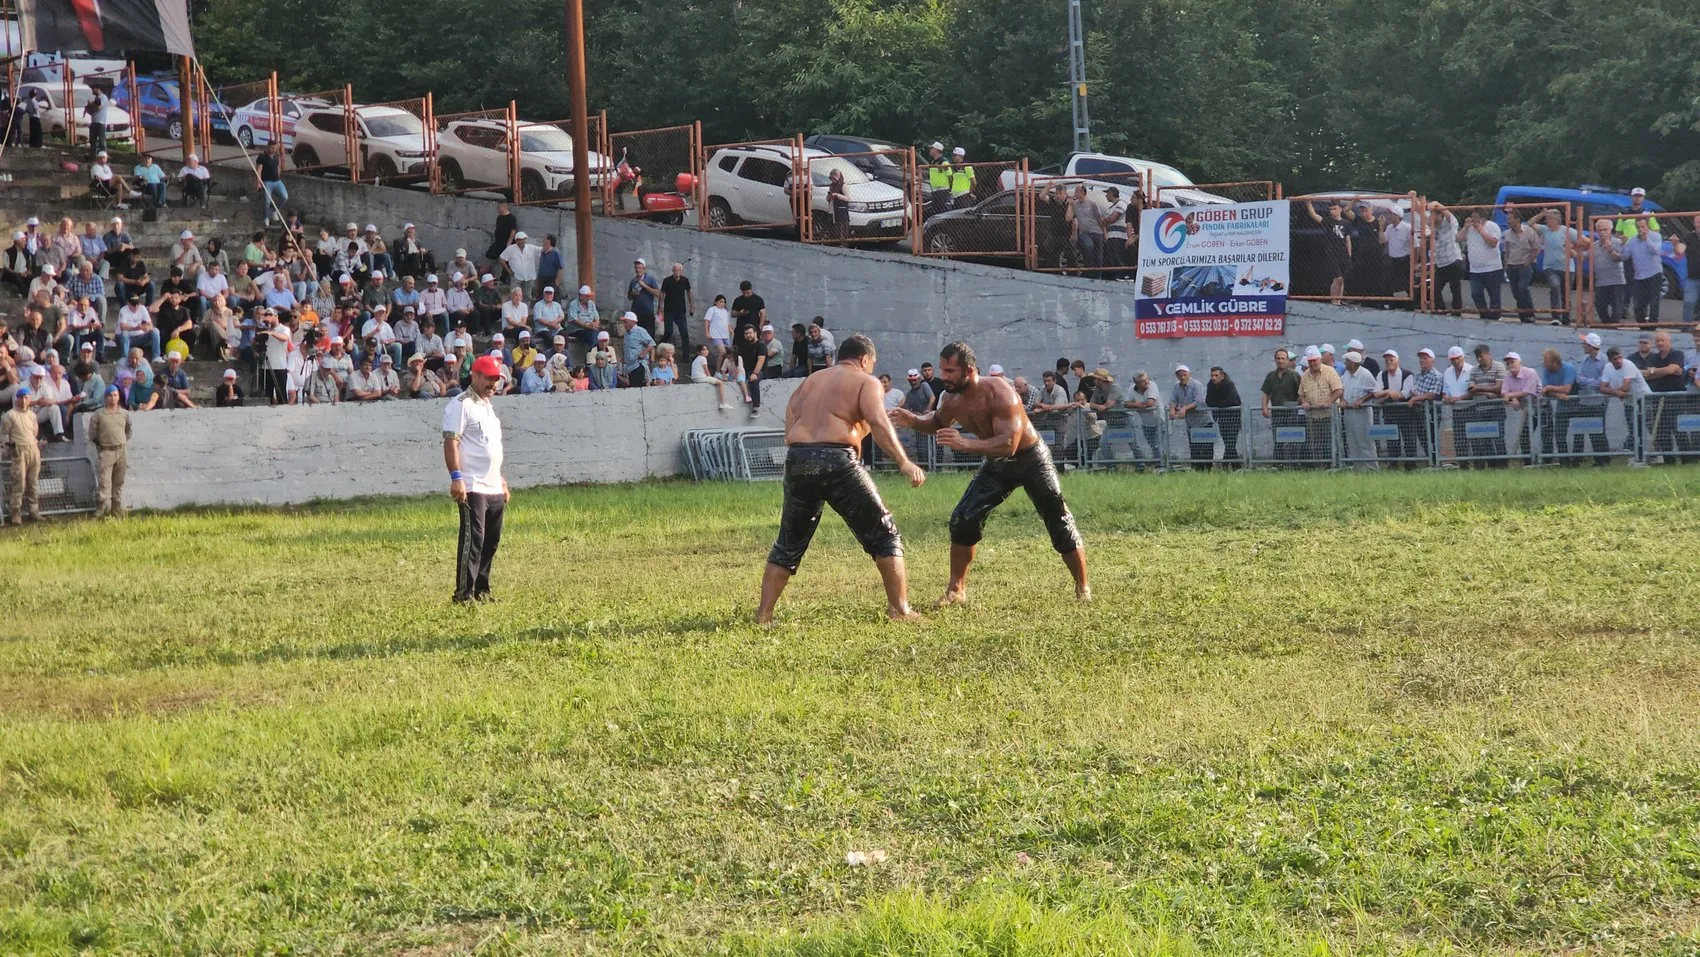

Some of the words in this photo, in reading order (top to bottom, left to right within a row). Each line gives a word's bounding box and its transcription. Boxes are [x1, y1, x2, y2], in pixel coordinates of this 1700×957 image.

[1196, 208, 1237, 222] GÖBEN
[1241, 207, 1273, 220] GRUP
[1158, 255, 1216, 267] SPORCULARIMIZA
[1218, 253, 1256, 265] BAŞARILAR
[1165, 299, 1216, 315] GEMLİK
[1218, 298, 1268, 313] GÜBRE
[1140, 322, 1145, 334] 0
[1183, 319, 1189, 332] 0
[1189, 319, 1200, 332] 533
[1234, 318, 1240, 331] 0
